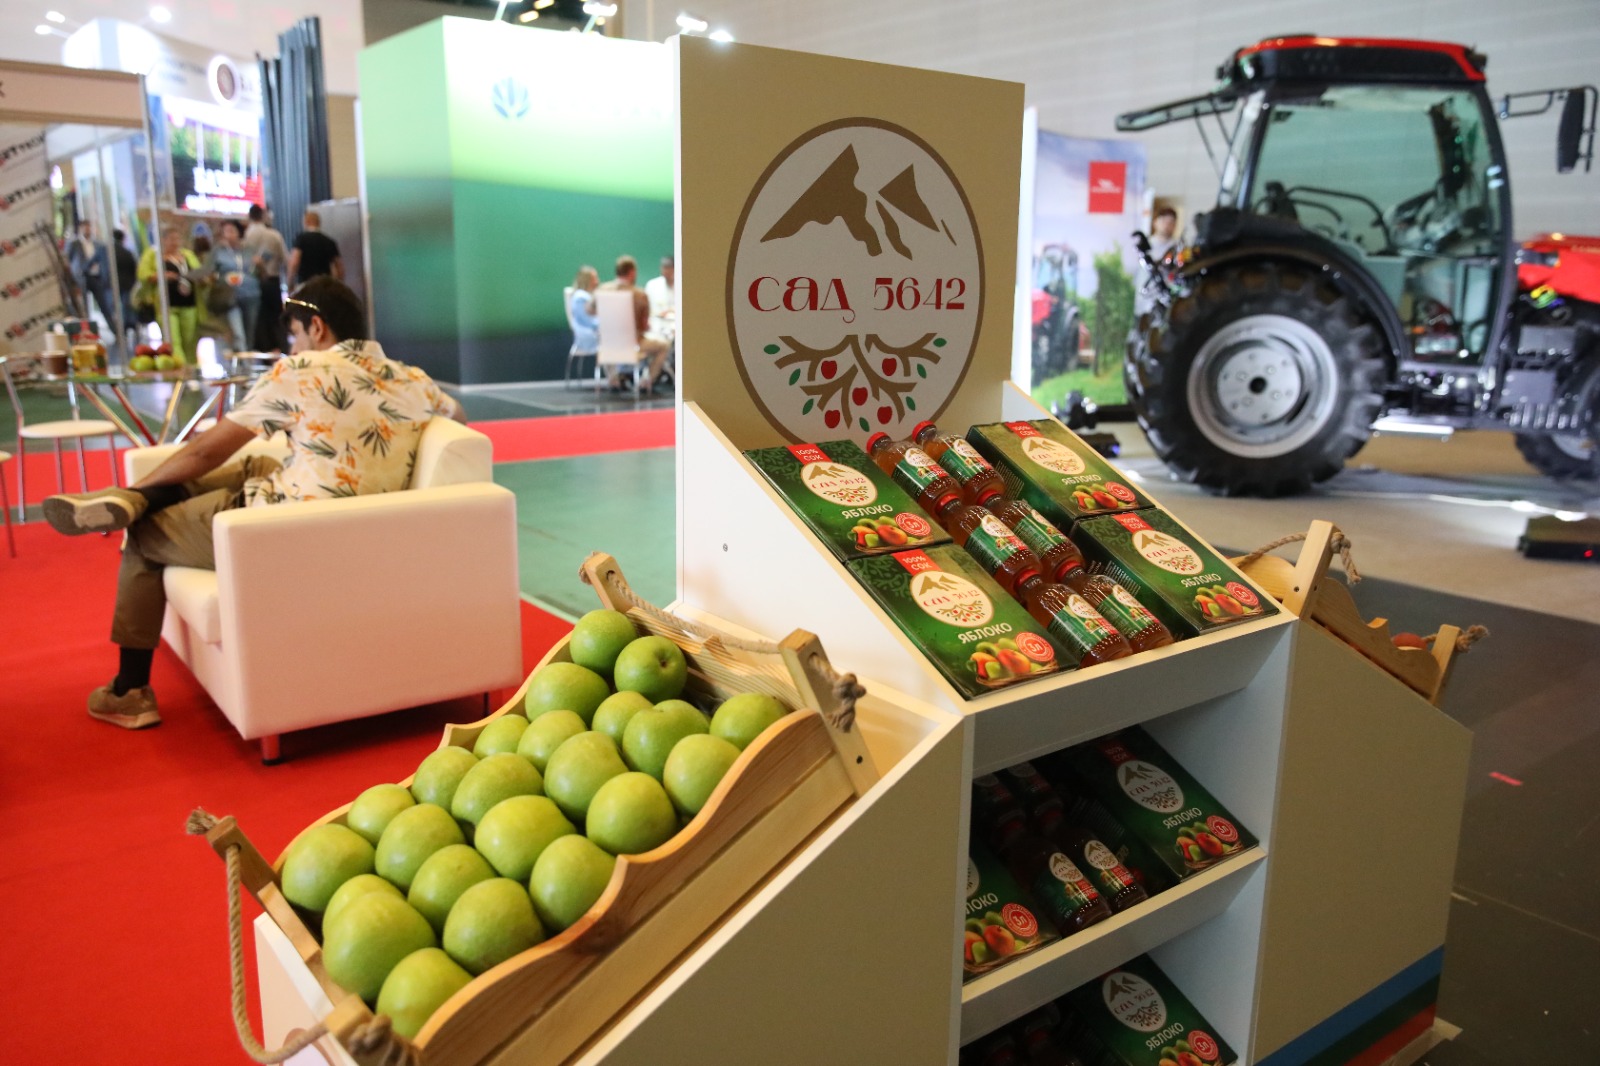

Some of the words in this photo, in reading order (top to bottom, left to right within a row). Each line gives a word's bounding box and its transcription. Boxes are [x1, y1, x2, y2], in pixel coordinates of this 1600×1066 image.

[873, 277, 966, 311] 5642
[796, 448, 819, 456] 100%
[803, 453, 824, 461] СОК
[1061, 474, 1102, 486] ЯБЛОКО
[841, 504, 894, 520] ЯБЛОКО
[902, 555, 926, 564] 100%
[911, 561, 933, 571] СОК
[1180, 573, 1222, 588] ЯБЛОКО
[957, 622, 1013, 644] ЯБЛОКО
[1027, 642, 1041, 653] 3л
[1162, 806, 1202, 829] ЯБЛОКО
[1216, 823, 1230, 834] 3л
[966, 892, 999, 915] ЛОКО
[1014, 914, 1028, 926] 3л
[1146, 1021, 1185, 1051] ЯБЛОКО
[1197, 1040, 1210, 1050] 3л
